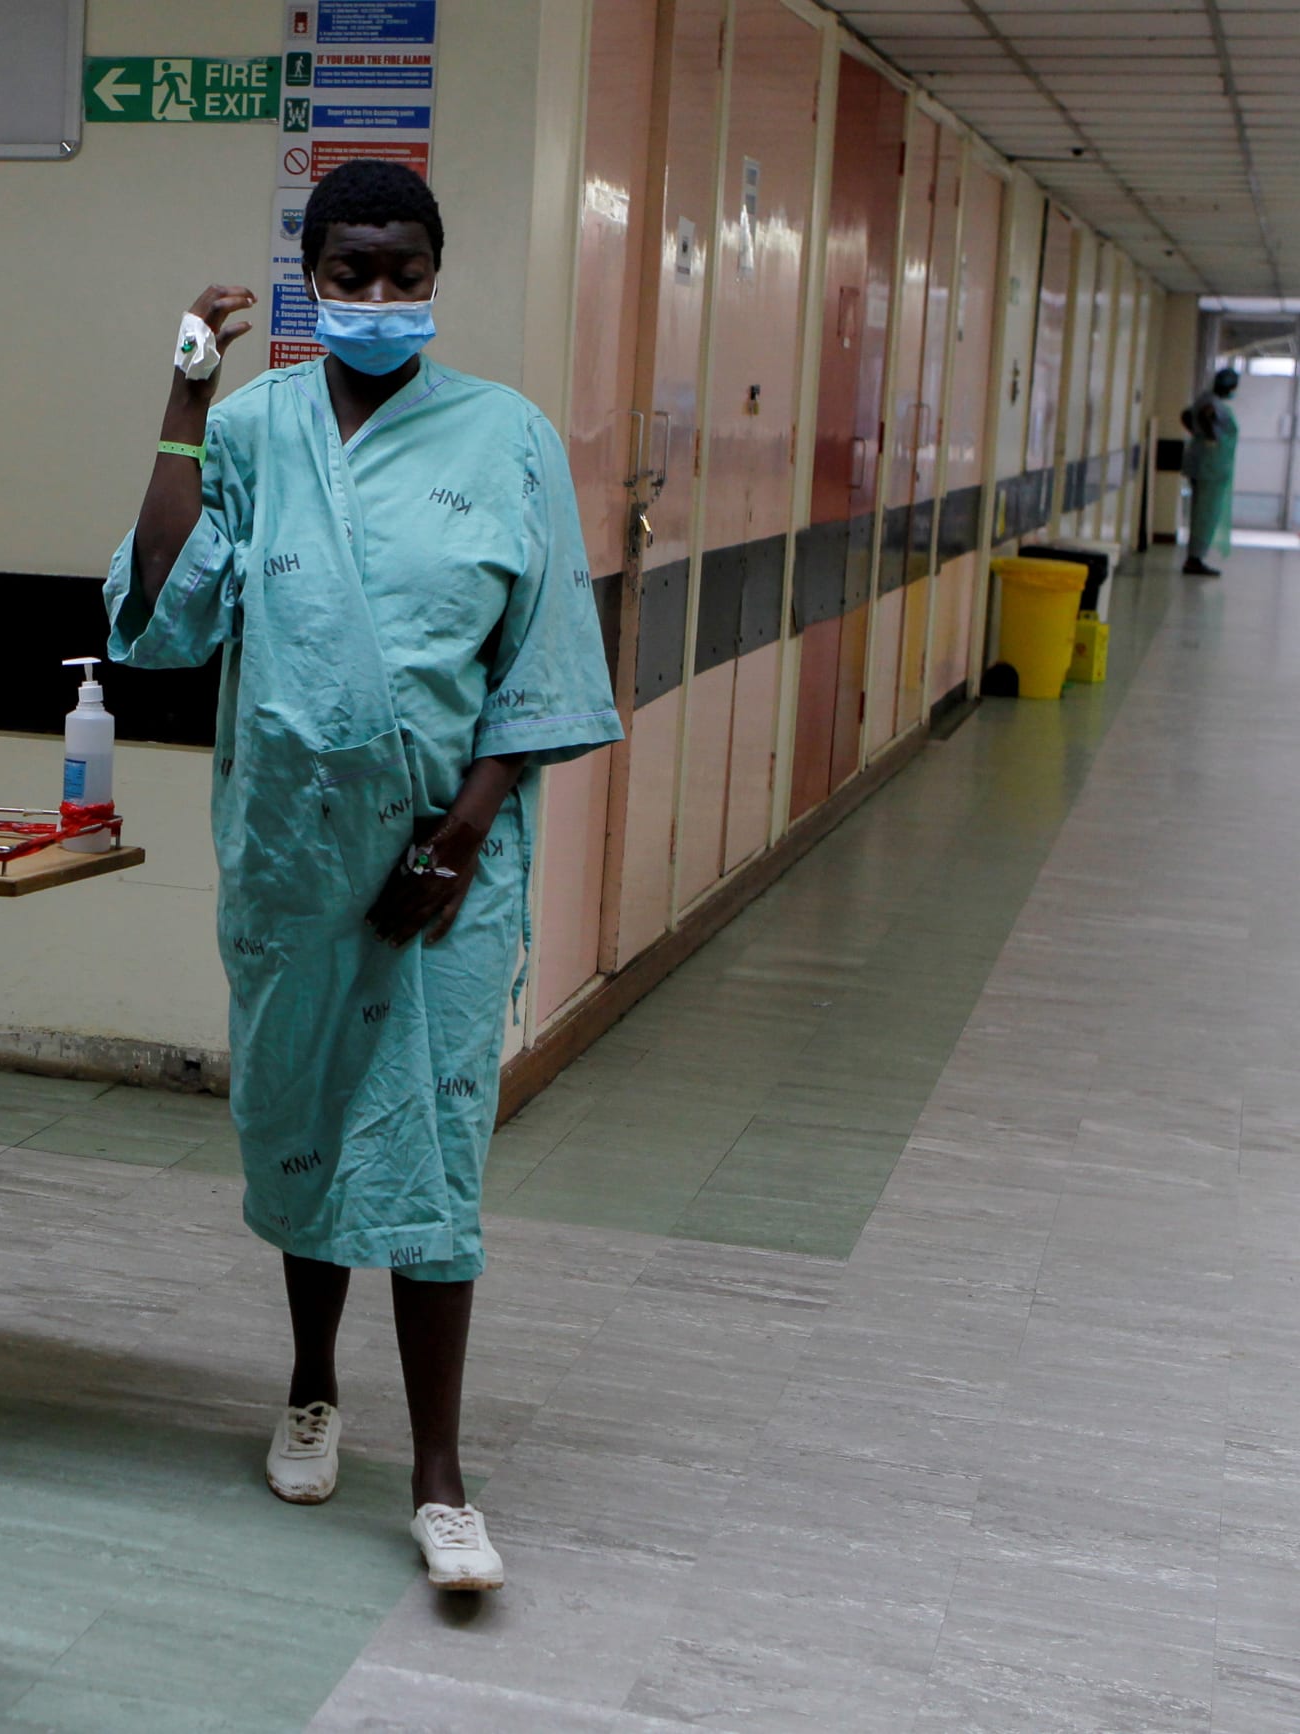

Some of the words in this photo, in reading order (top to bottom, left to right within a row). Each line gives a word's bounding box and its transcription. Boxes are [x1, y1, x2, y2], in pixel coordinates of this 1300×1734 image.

[316, 54, 324, 65] IF
[326, 54, 342, 65] YOU
[344, 54, 365, 65] HEAR
[367, 54, 381, 65] THE
[383, 54, 400, 65] FIRE
[402, 54, 431, 65] ALARM
[205, 63, 267, 88] FIRE
[204, 92, 267, 117] EXIT
[428, 487, 473, 516] KNH
[233, 936, 265, 956] KNH
[437, 1076, 476, 1098] KNH
[279, 1148, 323, 1176] KNH
